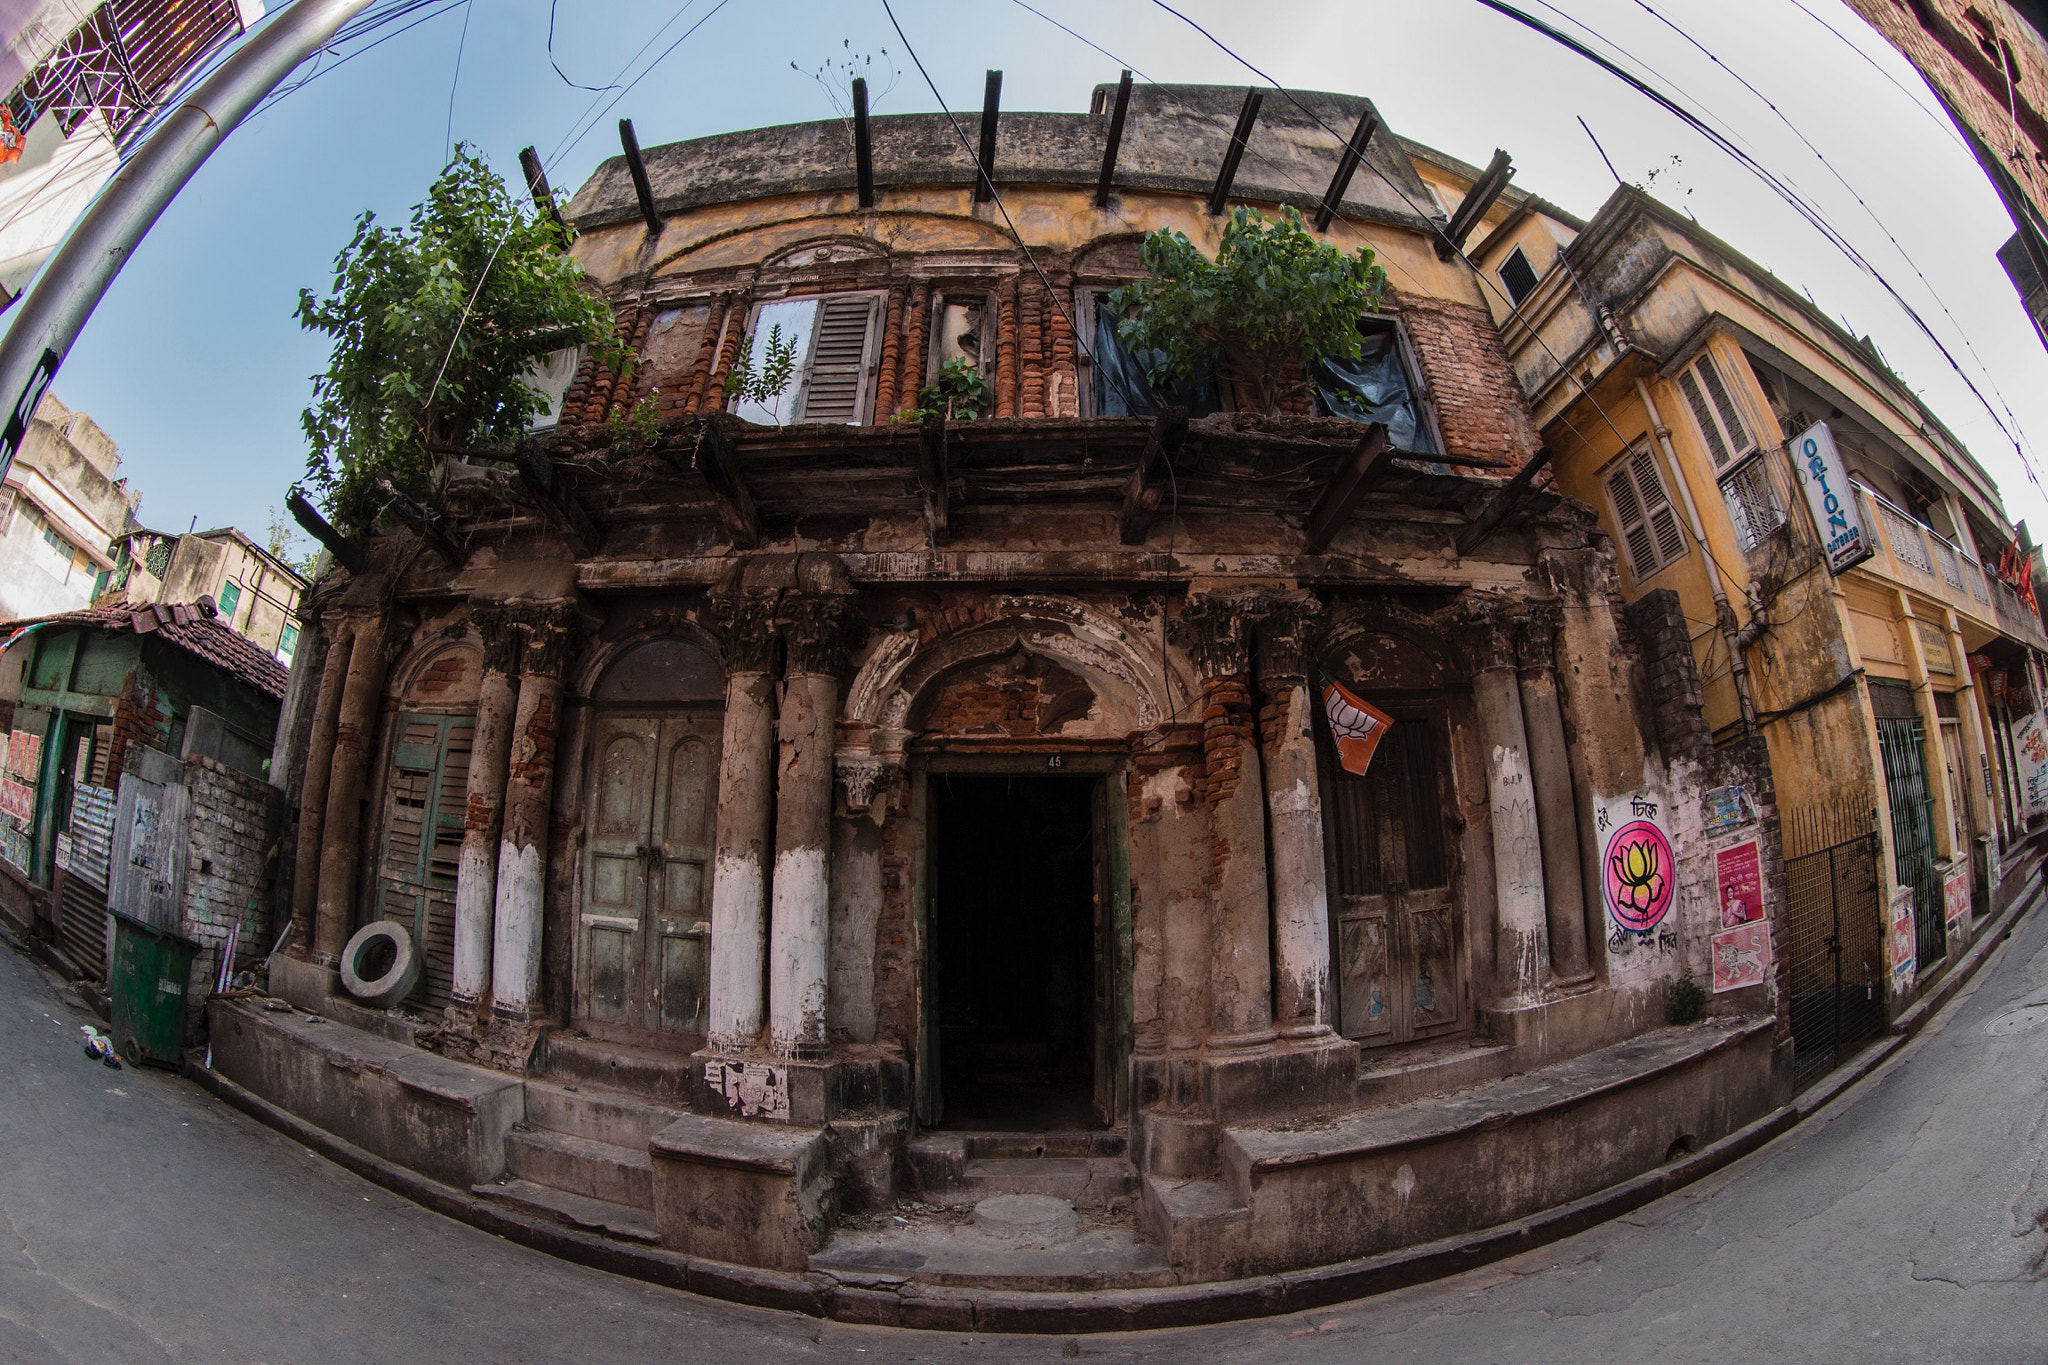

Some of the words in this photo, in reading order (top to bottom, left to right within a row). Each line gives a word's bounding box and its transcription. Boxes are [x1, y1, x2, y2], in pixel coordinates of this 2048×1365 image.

[1803, 438, 1847, 538] ORION
[1826, 525, 1860, 554] CATERER
[1048, 756, 1061, 768] 45
